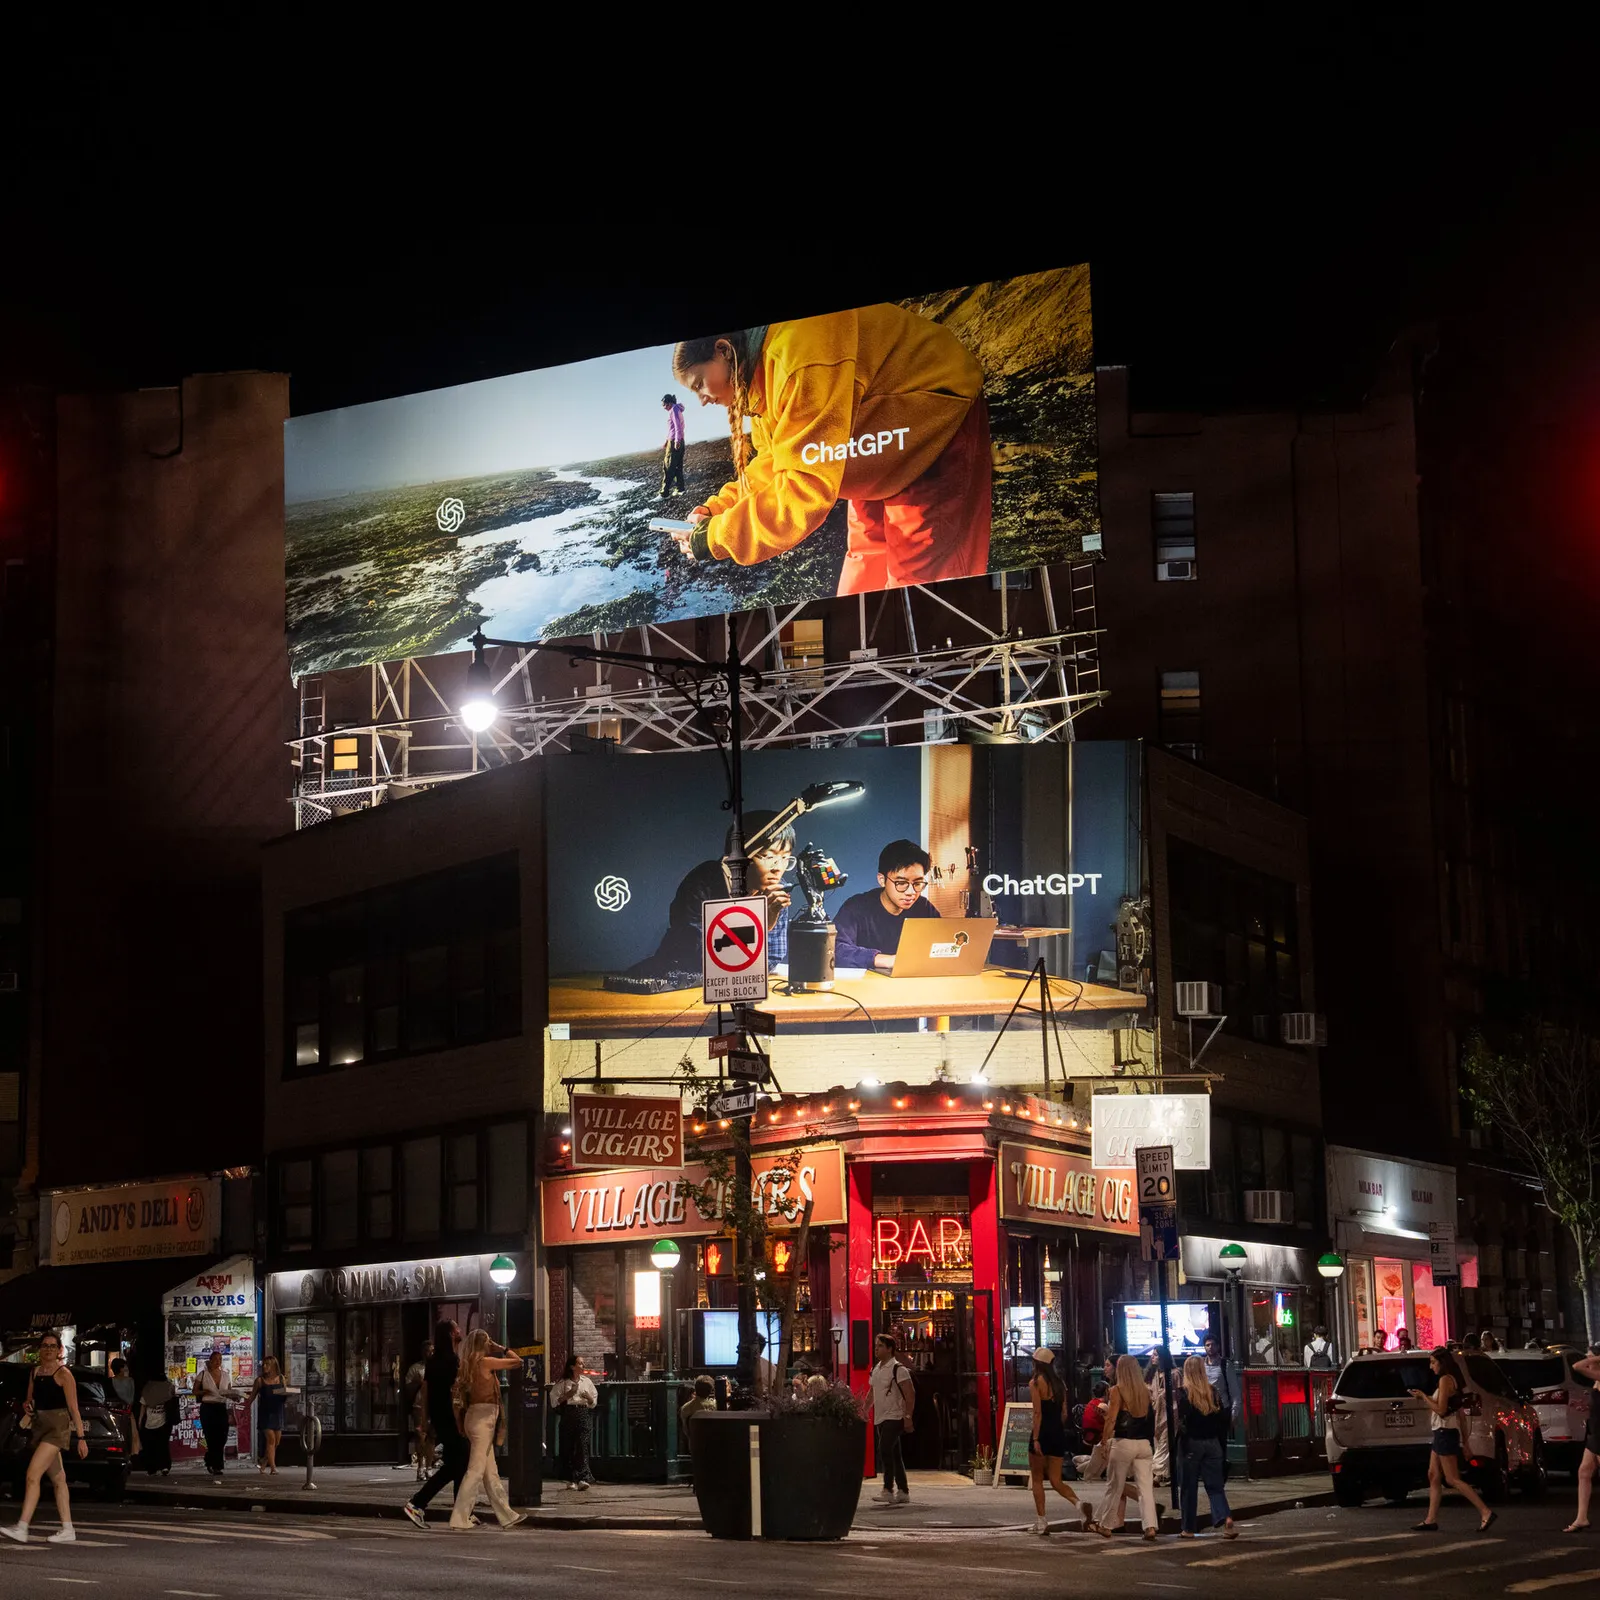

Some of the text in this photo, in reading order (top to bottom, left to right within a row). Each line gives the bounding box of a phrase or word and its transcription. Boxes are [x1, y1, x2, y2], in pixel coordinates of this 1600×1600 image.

[801, 427, 910, 466] ChatGPT
[982, 873, 1103, 896] ChatGPT
[706, 973, 765, 988] EXCEPT DELIVERIES
[714, 986, 758, 998] THIS BLOCK
[734, 1059, 764, 1073] ONE WAY
[717, 1094, 753, 1111] ONE WAY
[579, 1107, 677, 1131] VILLAGE
[580, 1132, 676, 1162] CIGARS
[1140, 1151, 1170, 1163] SPEED
[1142, 1162, 1168, 1174] LIMIT
[1011, 1161, 1132, 1222] VILLAGE CIG
[1143, 1175, 1171, 1197] 20
[563, 1181, 684, 1231] VILLAGE
[77, 1197, 178, 1234] ANDY'S DELI
[1155, 1219, 1175, 1228] ZONE
[876, 1218, 965, 1264] BAR
[196, 1274, 232, 1290] ATM
[350, 1268, 398, 1299] NAILS
[402, 1276, 411, 1295] &
[414, 1264, 447, 1293] SPA
[172, 1294, 246, 1308] FLOWERS
[184, 1325, 215, 1334] ANDY'S
[178, 1429, 194, 1440] FOR
